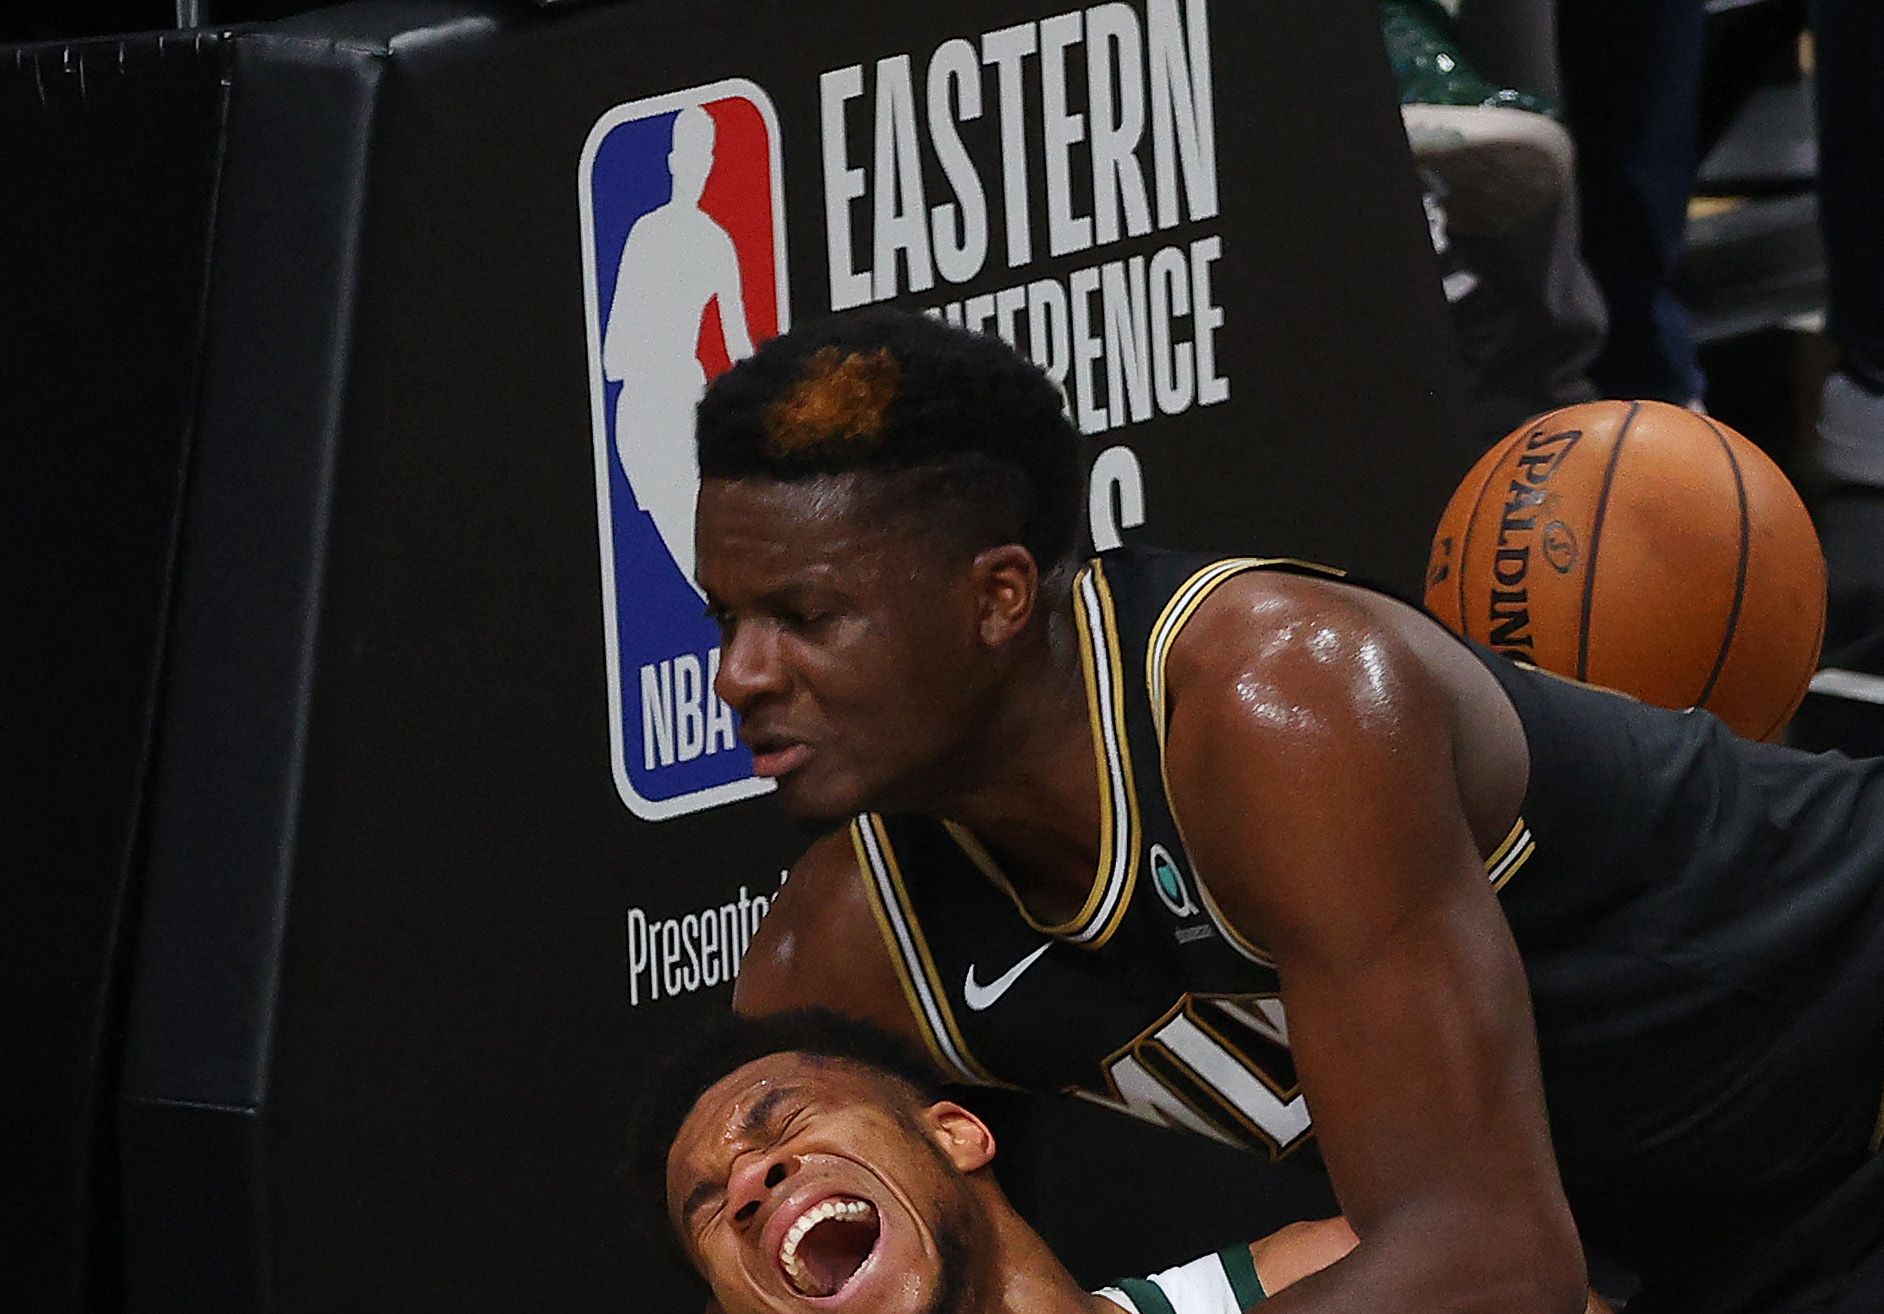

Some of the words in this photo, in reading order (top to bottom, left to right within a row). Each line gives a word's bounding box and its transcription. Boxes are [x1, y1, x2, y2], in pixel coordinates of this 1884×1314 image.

[820, 0, 1220, 313] EASTERN
[1488, 430, 1583, 666] SPALDIN
[639, 647, 738, 771] NBA
